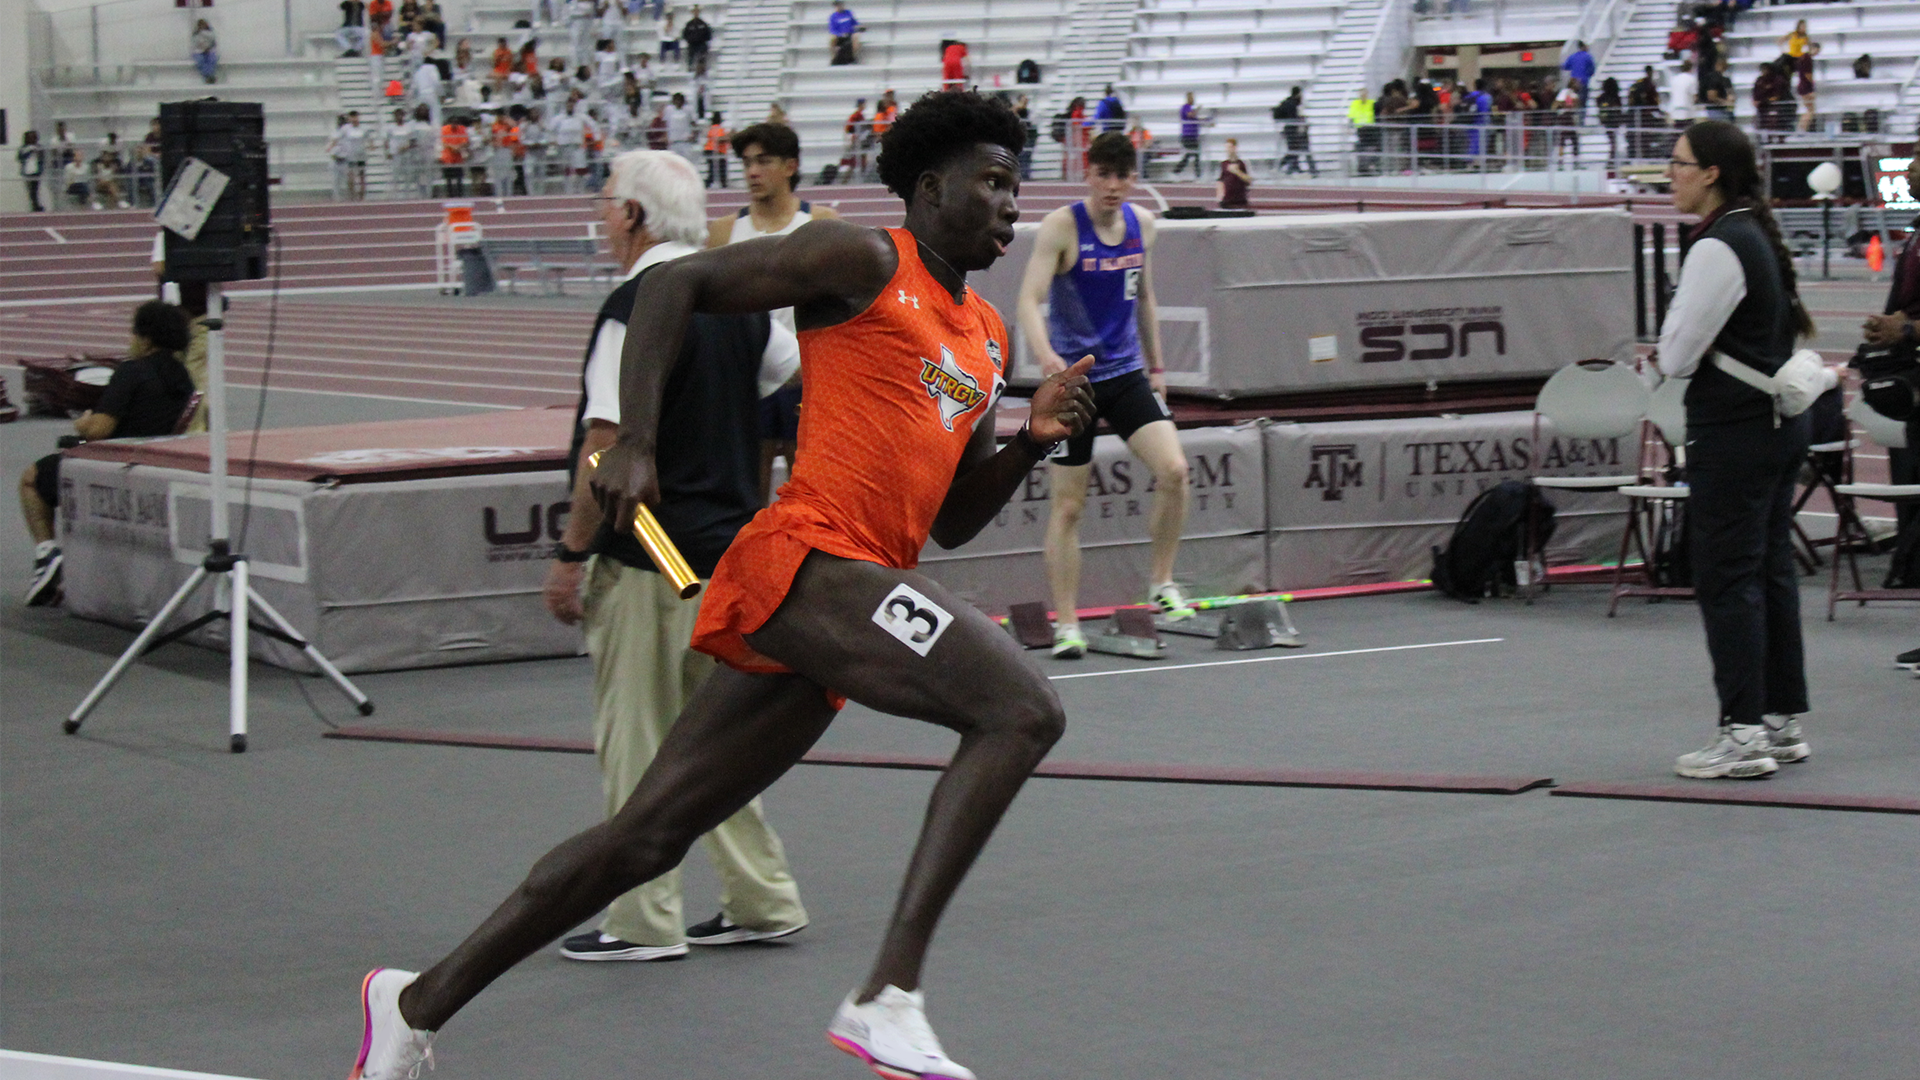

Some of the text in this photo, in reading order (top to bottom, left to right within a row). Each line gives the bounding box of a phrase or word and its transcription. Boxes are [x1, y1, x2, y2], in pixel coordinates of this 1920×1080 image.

[1360, 321, 1505, 363] UCS
[921, 364, 984, 407] UTRGV
[1404, 436, 1622, 475] TEXAS A&M
[484, 501, 572, 545] UC
[884, 594, 939, 644] 3
